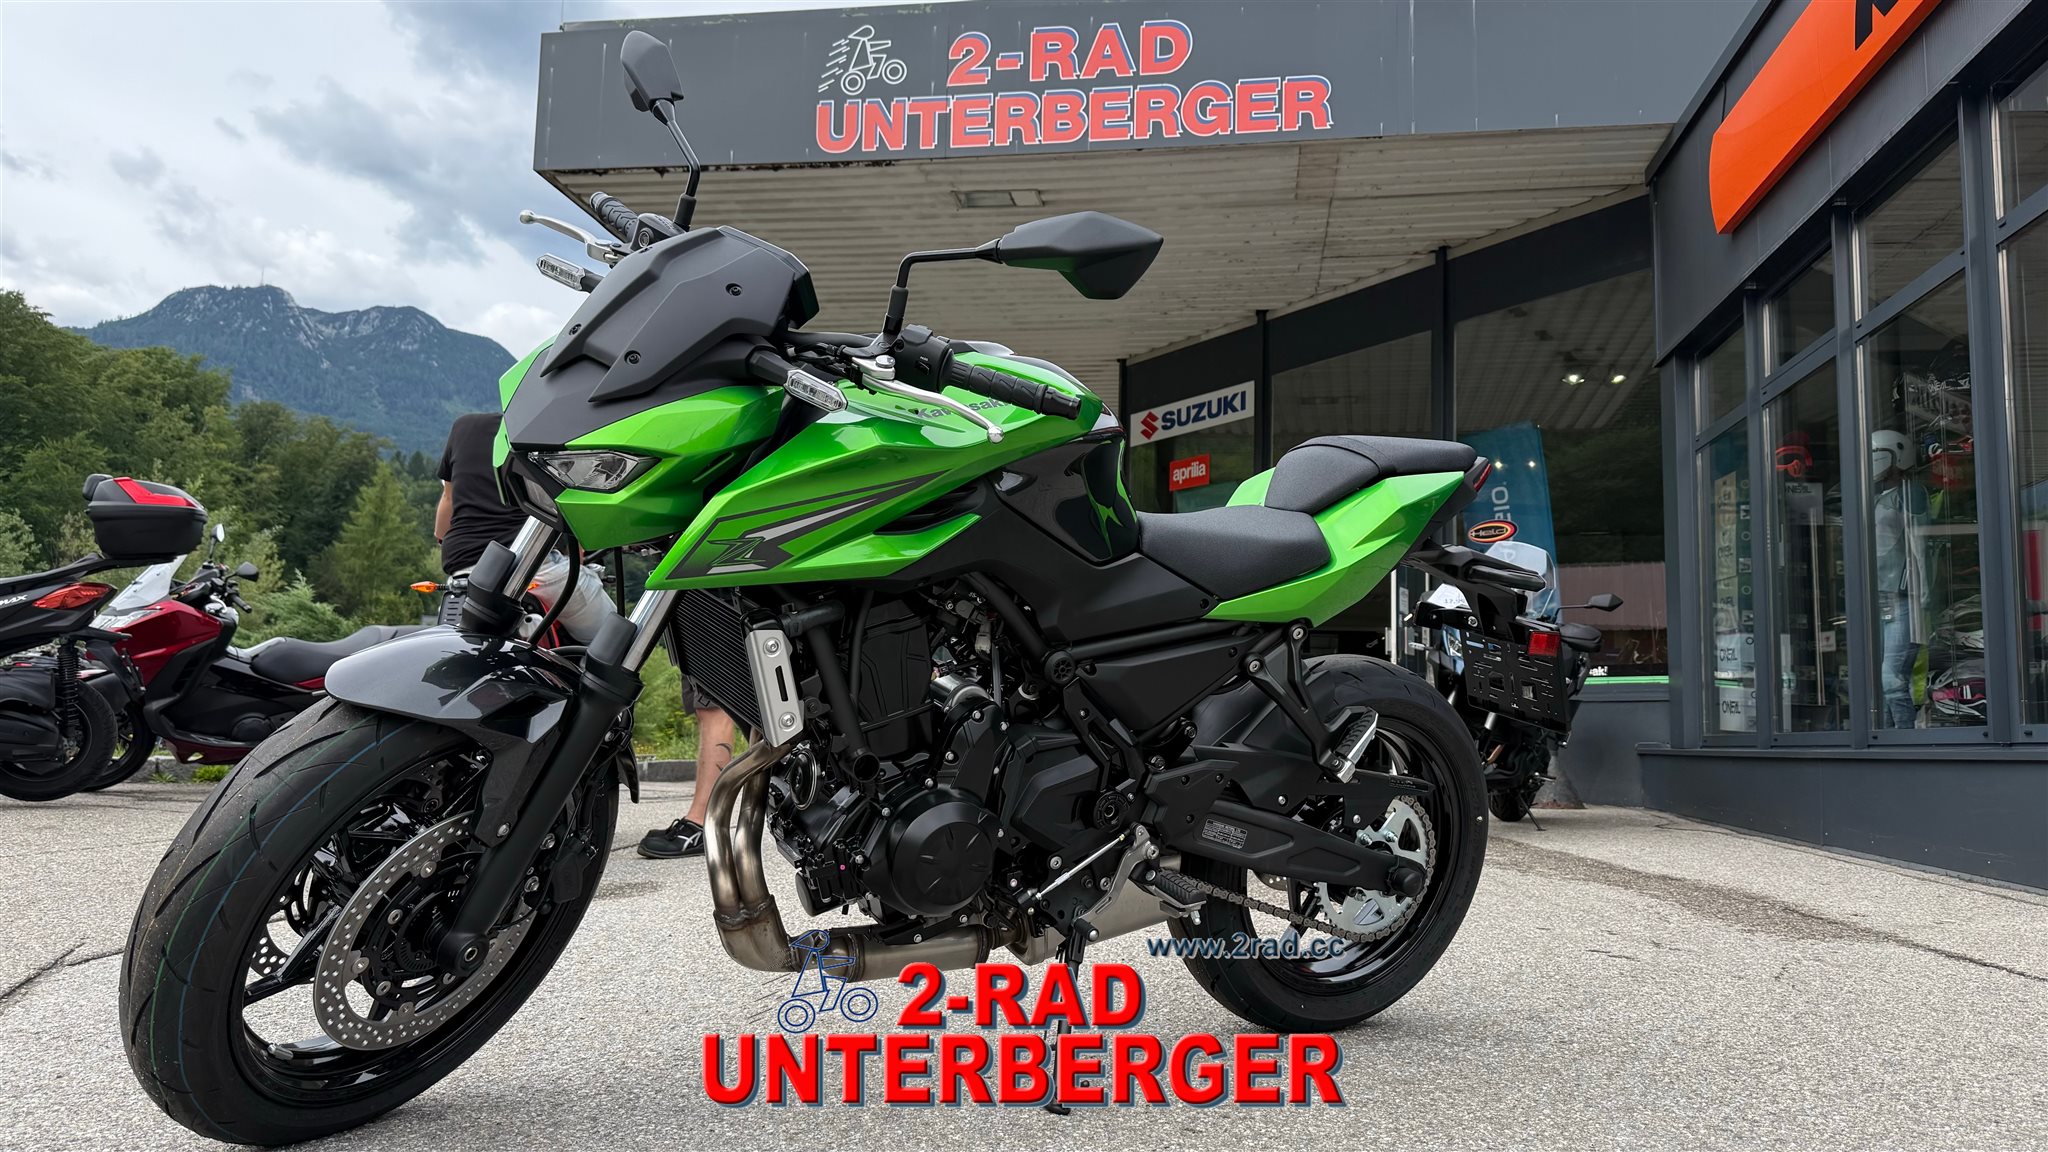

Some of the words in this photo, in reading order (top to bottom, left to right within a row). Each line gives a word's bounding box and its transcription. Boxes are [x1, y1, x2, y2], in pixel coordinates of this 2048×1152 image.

[947, 19, 1193, 88] 2-RAD
[815, 74, 1334, 154] UNTERBERGER
[1161, 390, 1247, 431] SUZUKI
[1172, 461, 1207, 485] aprilia
